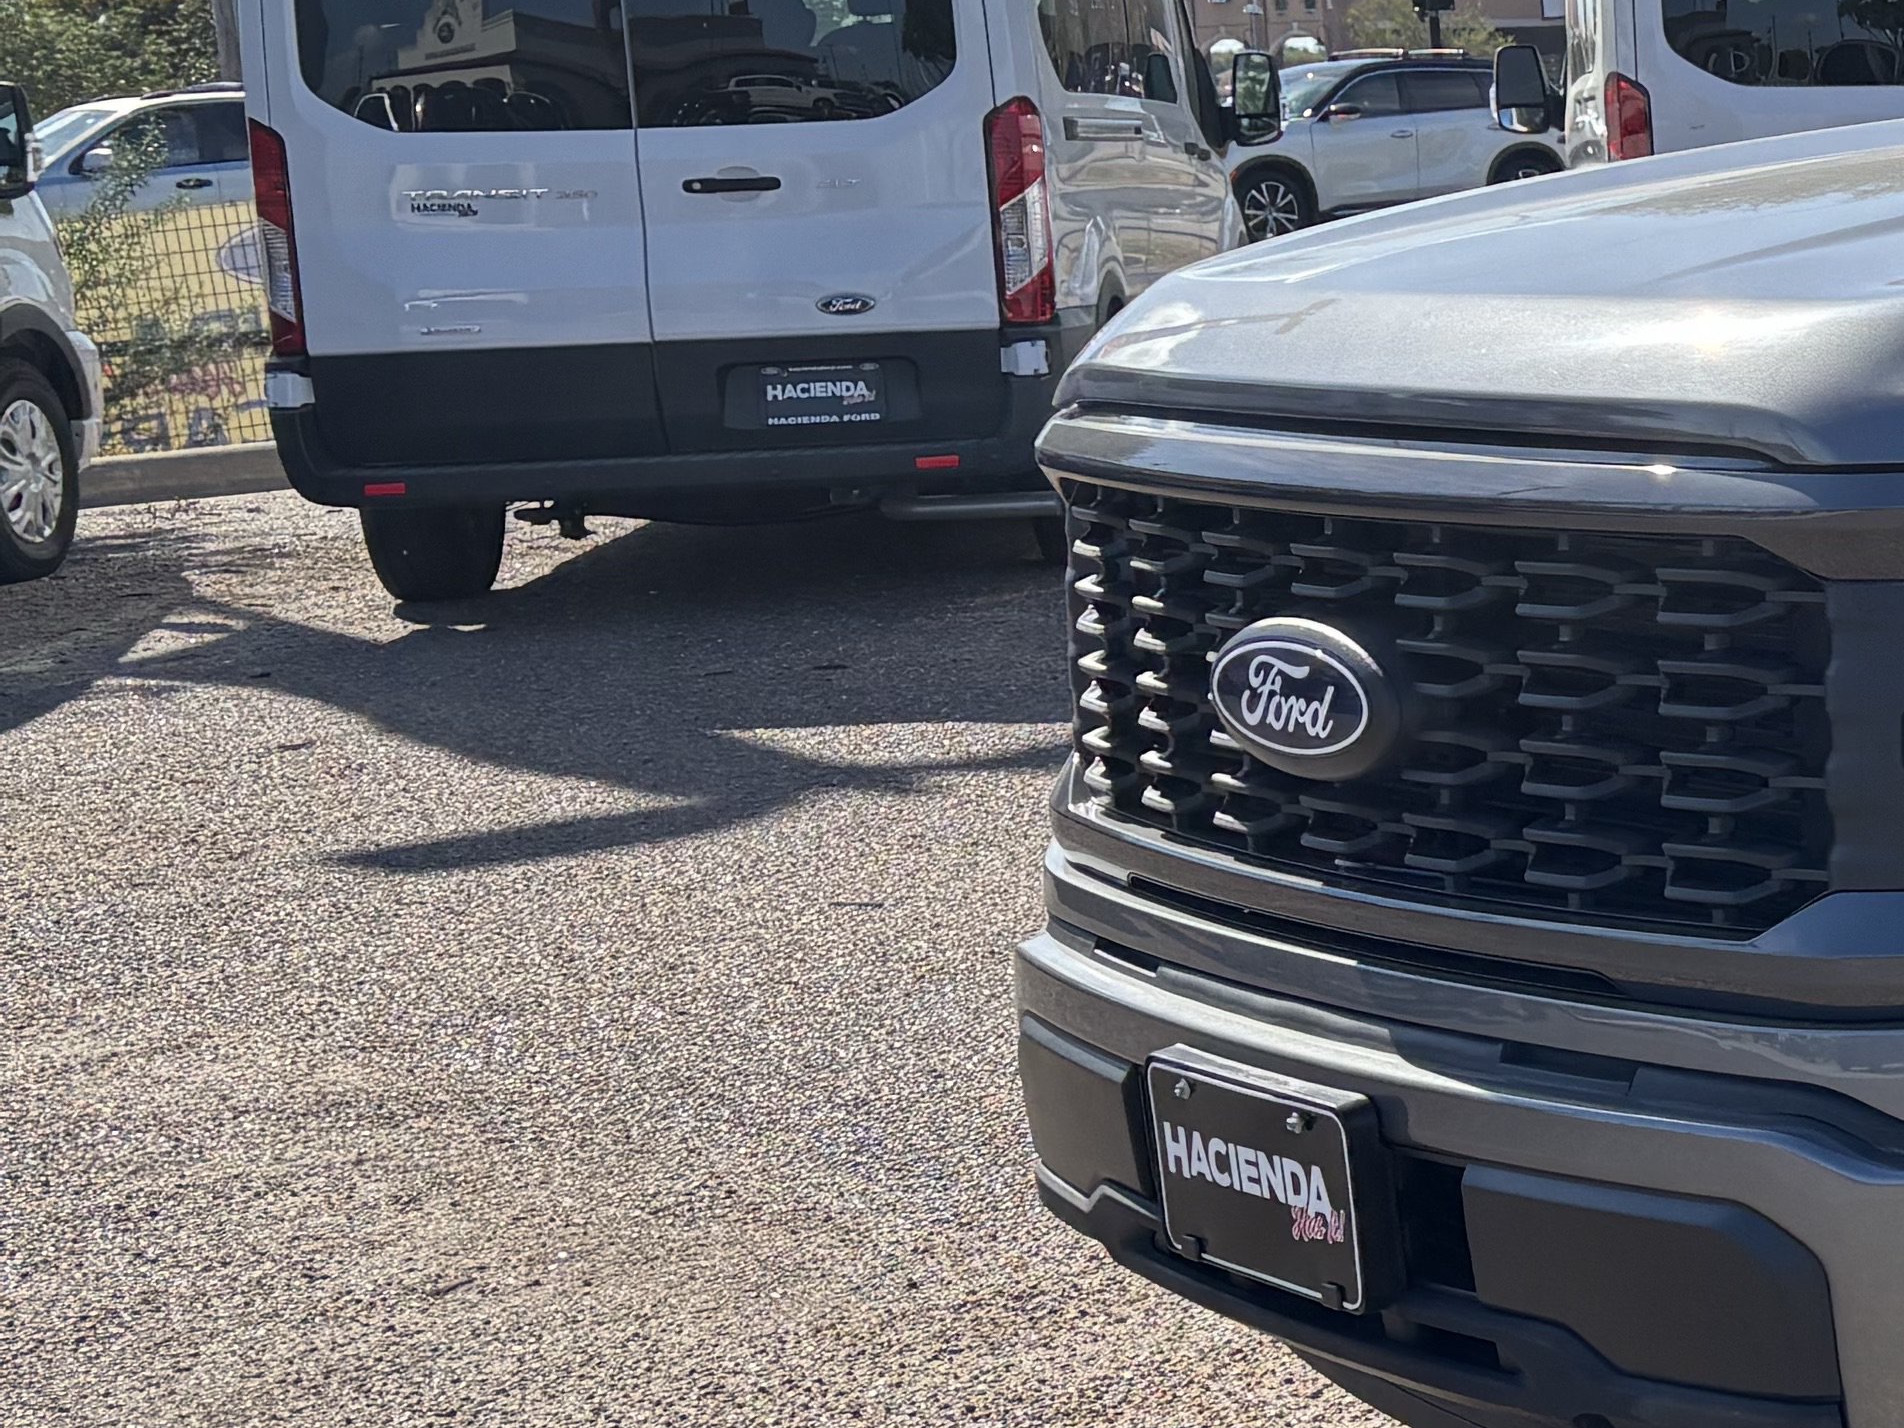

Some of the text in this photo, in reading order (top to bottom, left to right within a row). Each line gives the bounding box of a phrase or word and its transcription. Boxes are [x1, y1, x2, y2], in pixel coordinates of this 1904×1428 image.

[402, 188, 549, 202] TRANSIT
[410, 202, 472, 214] HACIENDA
[829, 297, 863, 312] Ford
[766, 381, 869, 402] HACIENDA
[767, 413, 881, 426] HACIENDA FORD
[1240, 654, 1335, 739] Ford
[1162, 1121, 1332, 1219] HACIENDA
